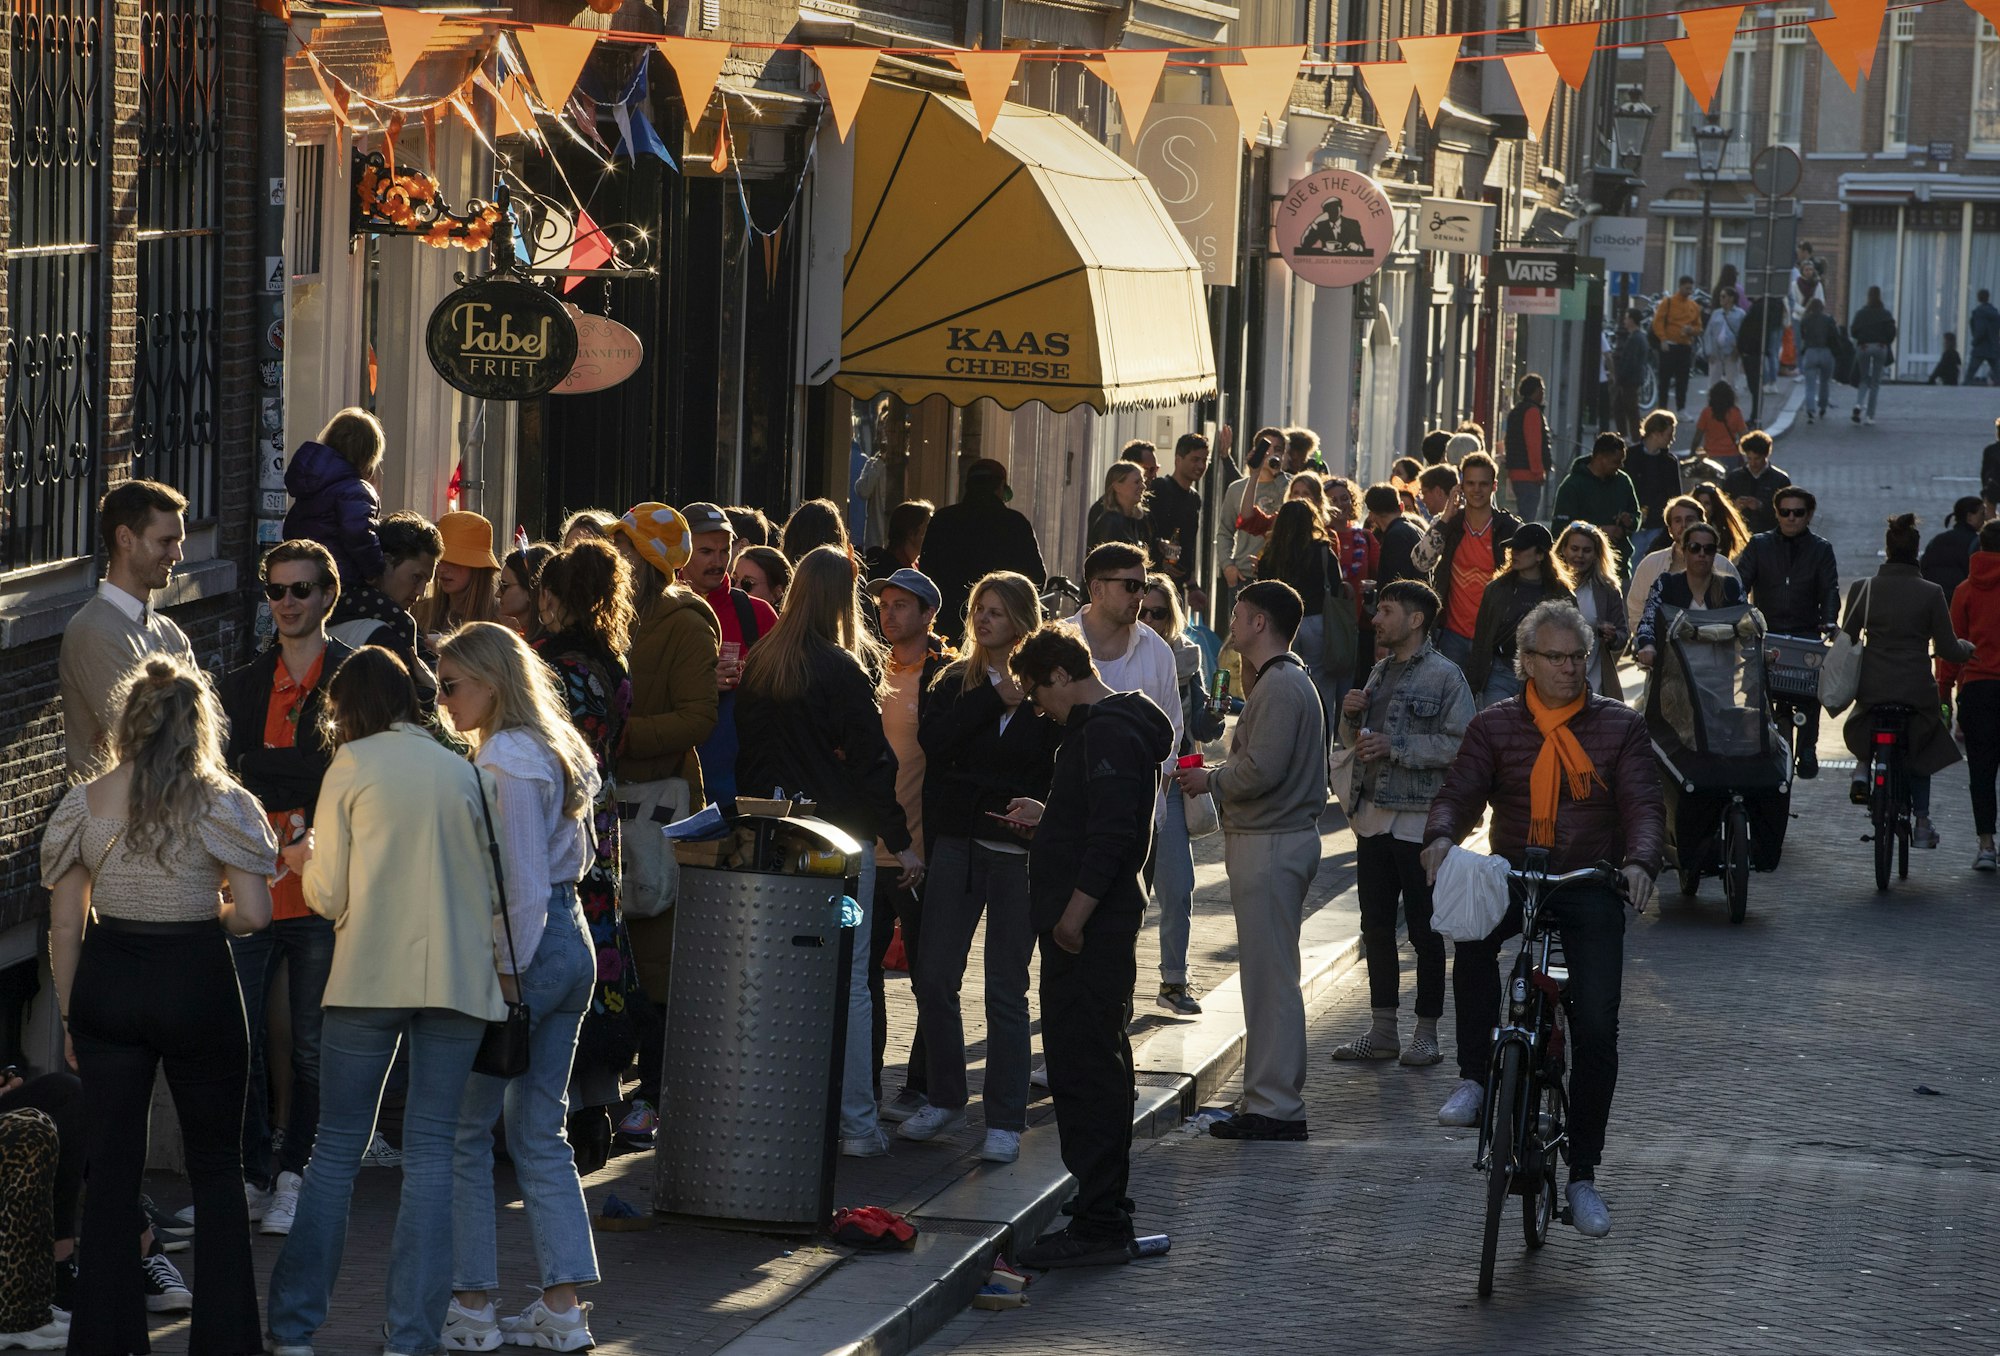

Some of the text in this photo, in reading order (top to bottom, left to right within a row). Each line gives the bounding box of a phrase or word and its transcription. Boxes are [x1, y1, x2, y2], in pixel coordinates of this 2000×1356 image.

[1286, 177, 1385, 219] JOE & THE JUICE
[1433, 233, 1465, 243] DENHAM
[1505, 259, 1559, 282] VANS
[452, 302, 552, 361] Fabel
[946, 327, 1070, 357] KAAS
[470, 358, 537, 378] FRIET
[945, 357, 1070, 379] CHEESE
